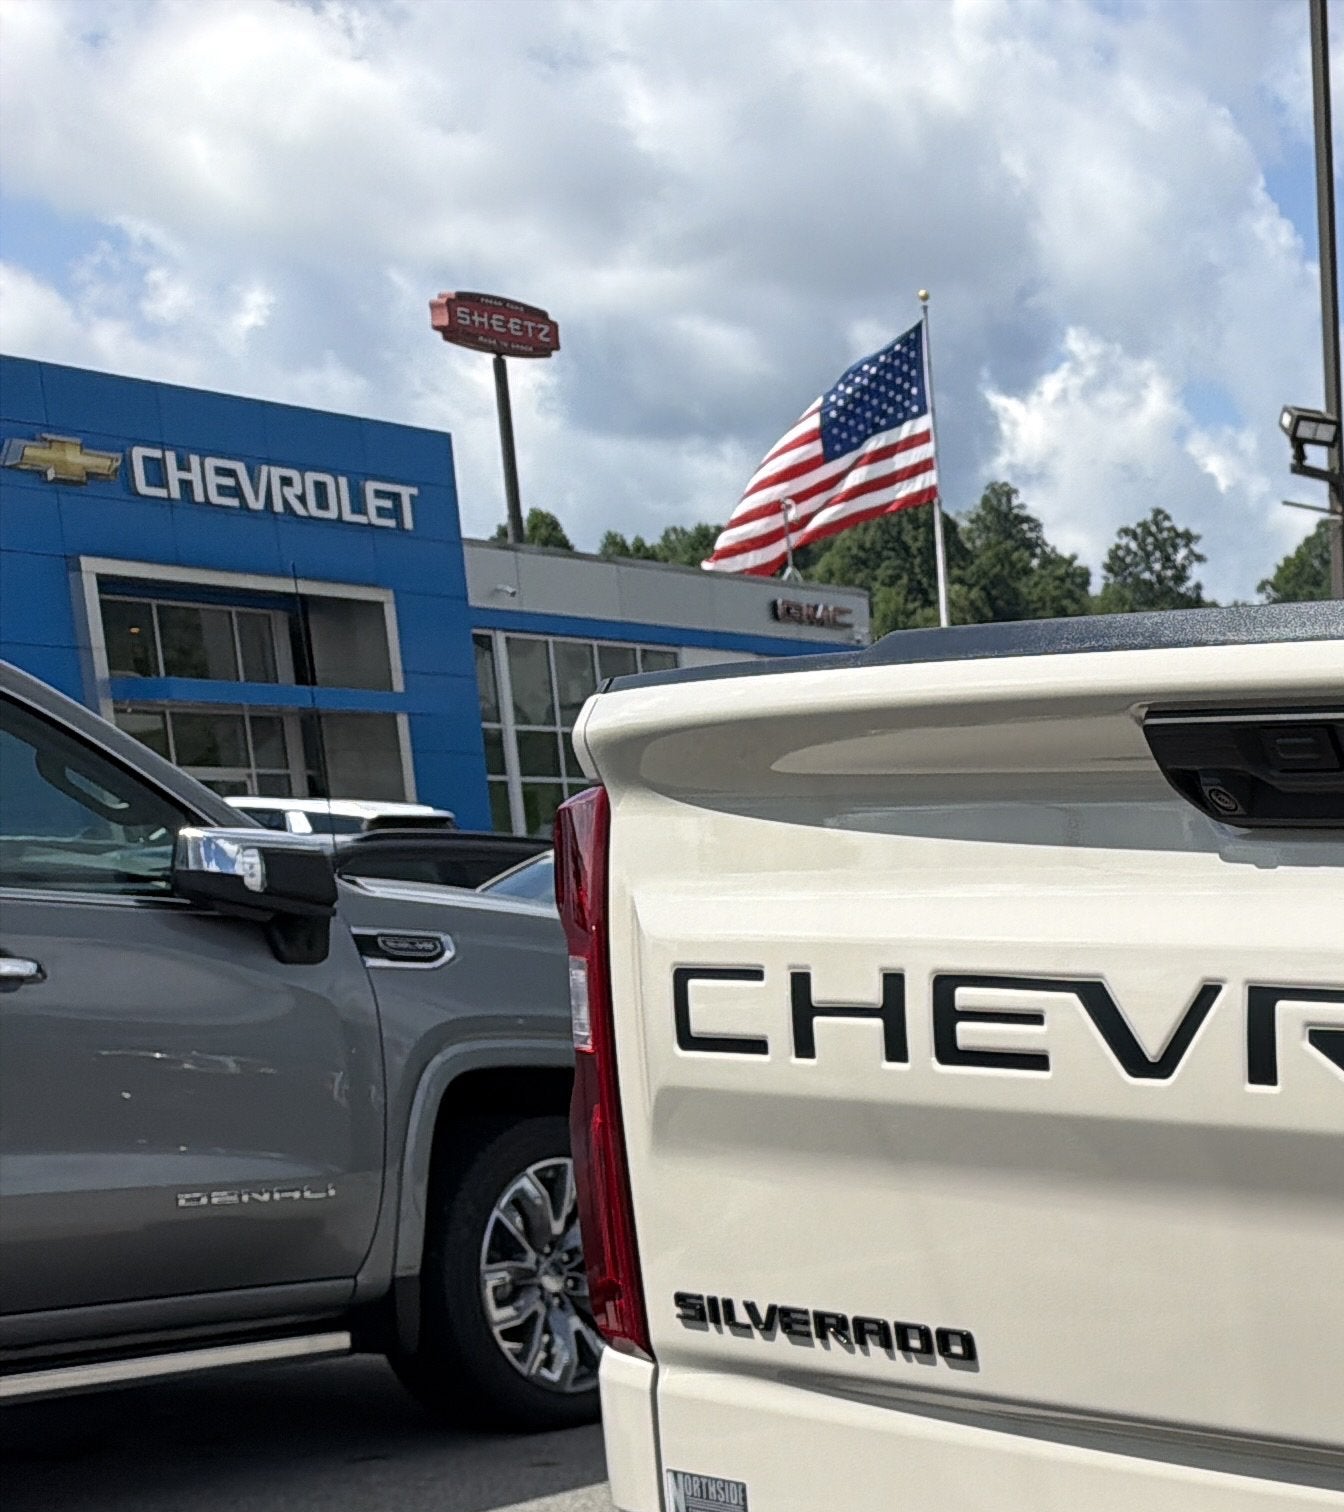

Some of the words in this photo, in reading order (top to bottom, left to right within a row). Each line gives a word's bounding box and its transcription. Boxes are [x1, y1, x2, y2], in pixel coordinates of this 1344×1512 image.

[456, 307, 551, 343] SHEETZ
[130, 446, 419, 531] CHEVROLET
[177, 1183, 336, 1207] DENALI
[673, 1290, 977, 1362] SILVERADO
